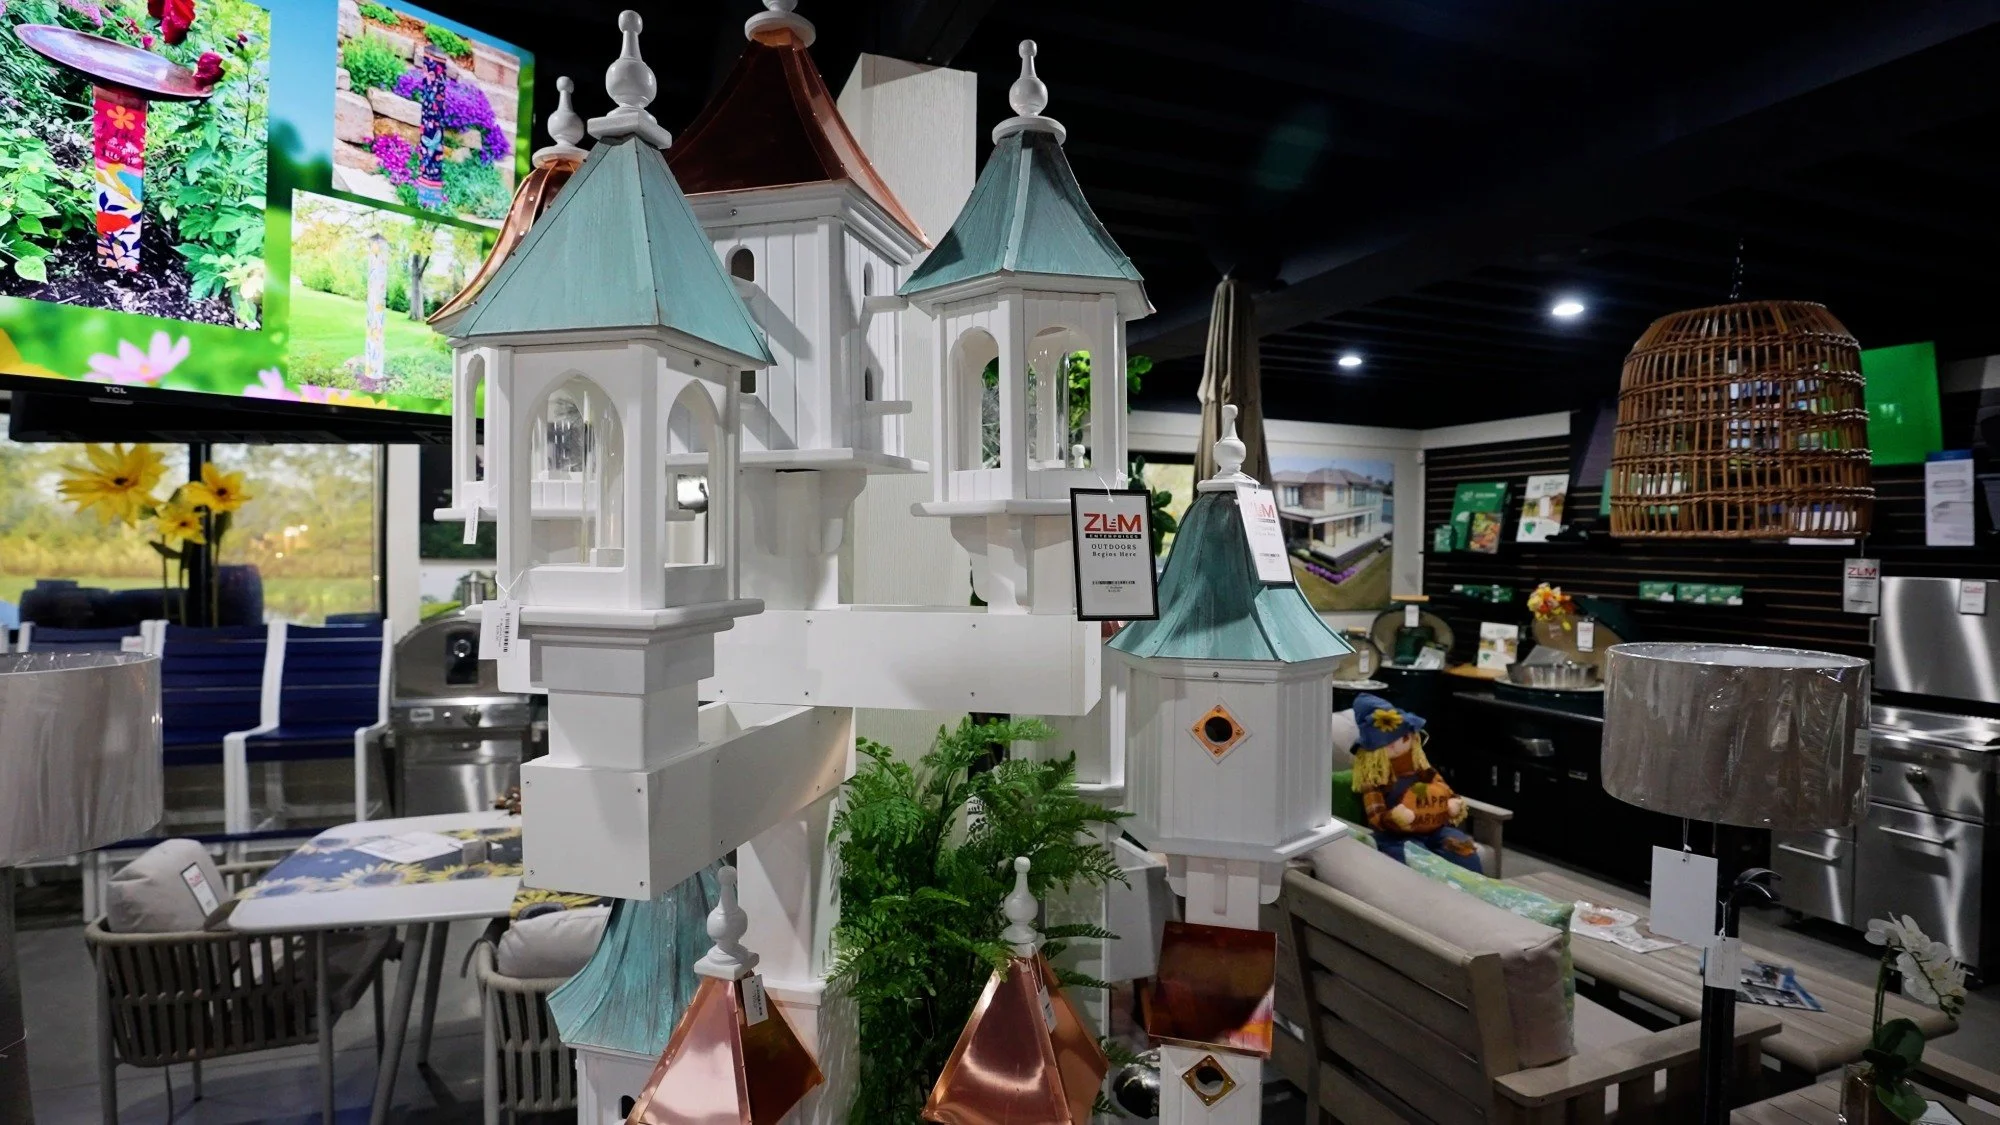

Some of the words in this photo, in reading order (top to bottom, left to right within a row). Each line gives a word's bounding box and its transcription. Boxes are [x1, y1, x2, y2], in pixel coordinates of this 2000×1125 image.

[104, 386, 127, 394] TCL
[1083, 513, 1142, 532] ZLM
[1091, 543, 1137, 551] OUTDOORS
[1848, 567, 1877, 576] ZLM
